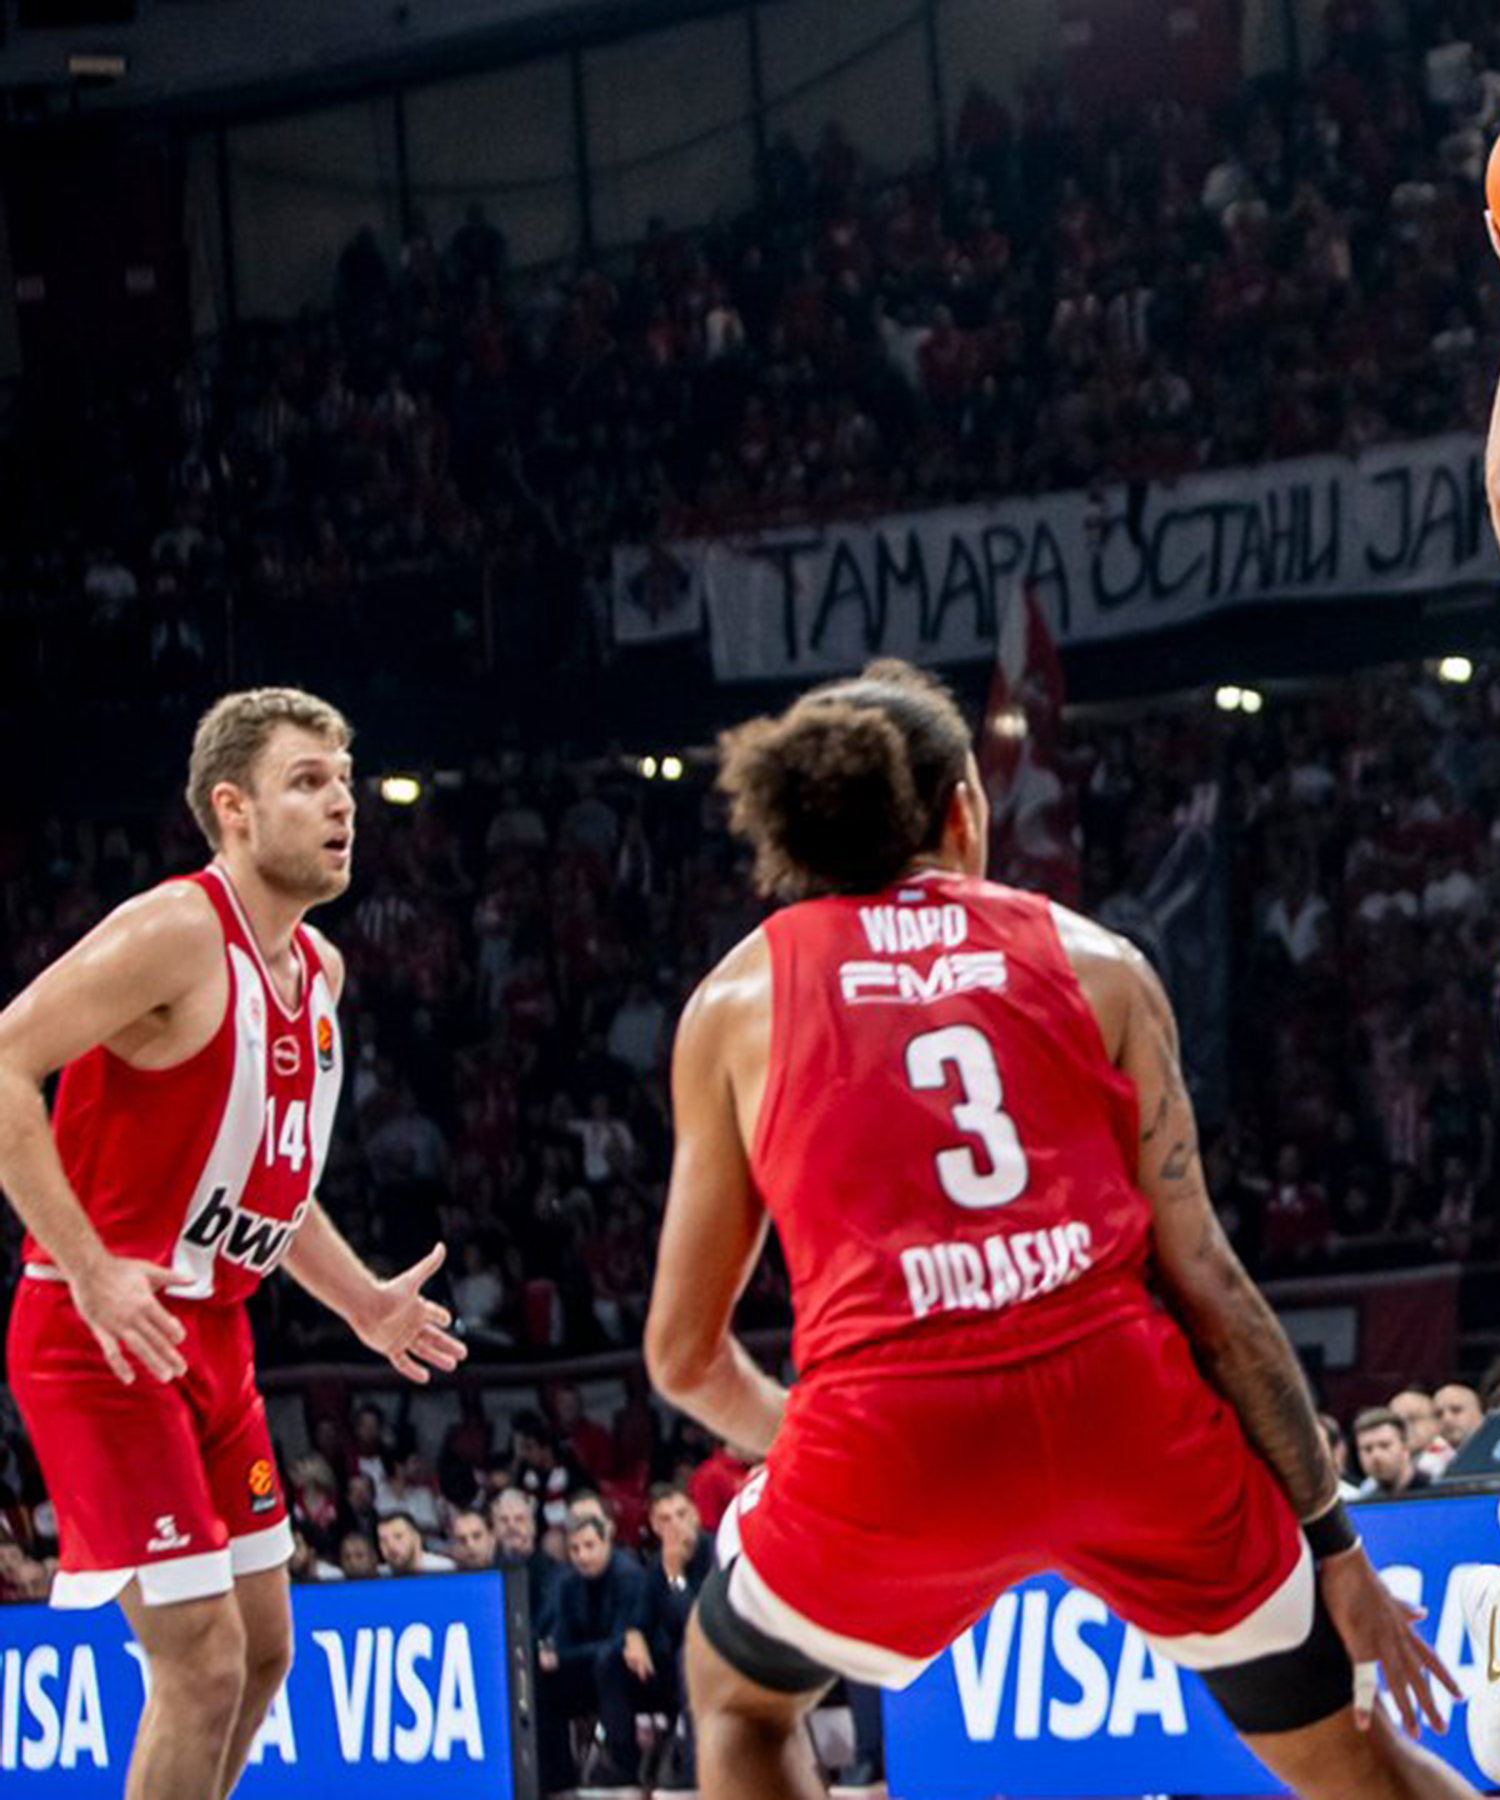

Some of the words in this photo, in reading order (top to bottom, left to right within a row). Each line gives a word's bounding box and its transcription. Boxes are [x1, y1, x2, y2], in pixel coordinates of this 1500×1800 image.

[858, 904, 968, 954] WARD
[265, 1096, 306, 1172] 14
[905, 1023, 1029, 1211] 3
[900, 1220, 1093, 1320] PIRAEUS
[0, 1643, 109, 1770] ISA
[311, 1621, 486, 1764] VISA
[949, 1586, 1188, 1741] VISA
